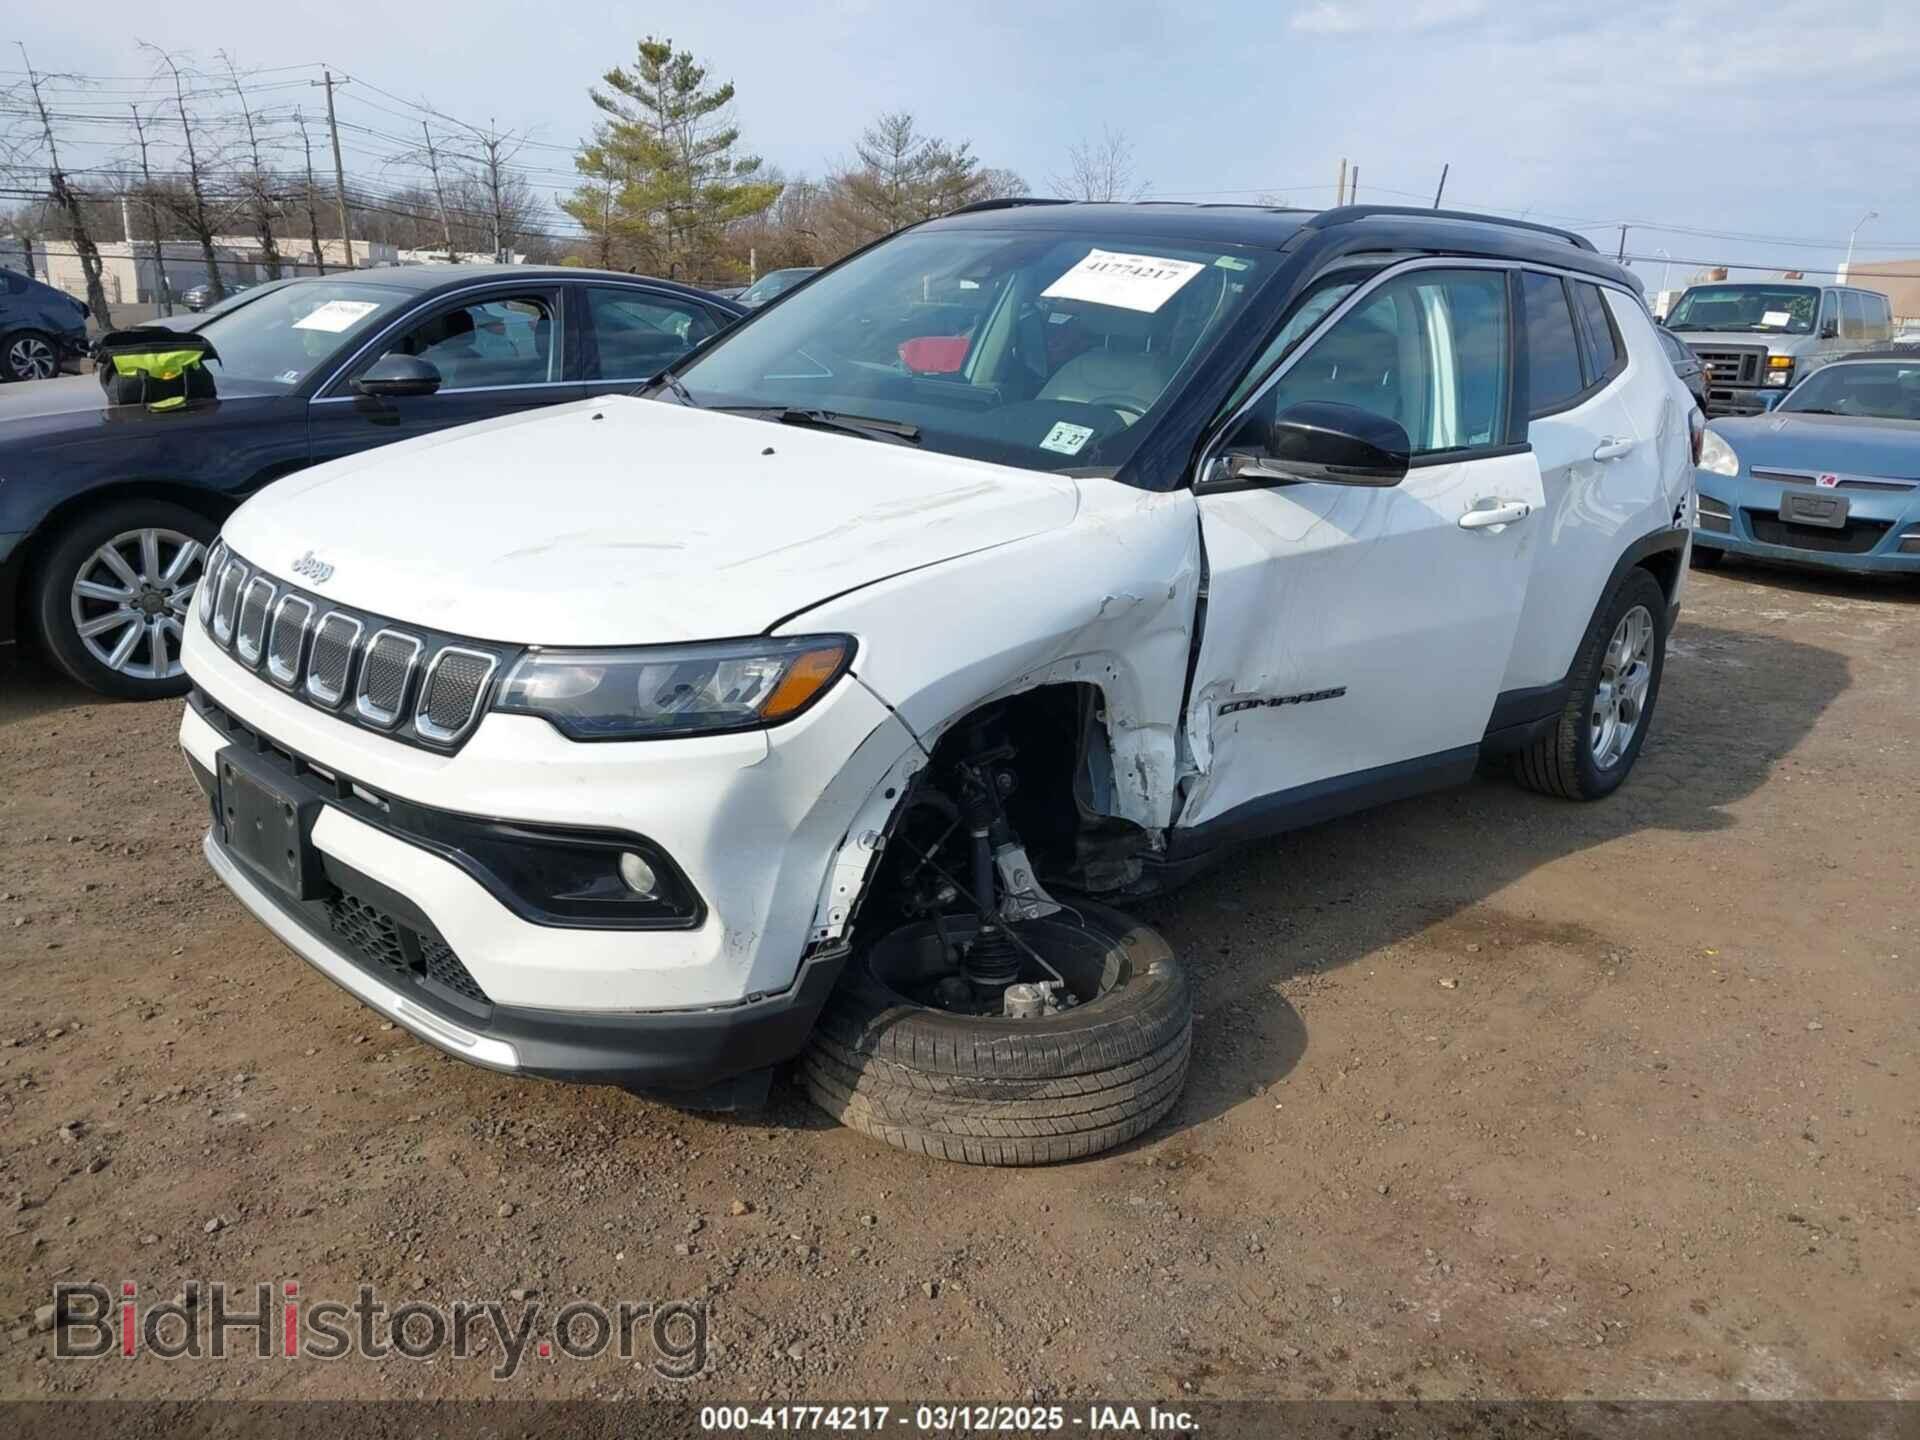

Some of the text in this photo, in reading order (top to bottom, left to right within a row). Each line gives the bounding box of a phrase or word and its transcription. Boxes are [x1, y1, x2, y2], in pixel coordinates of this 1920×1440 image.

[1087, 262, 1179, 281] 41774217
[1052, 431, 1085, 446] 3 27
[292, 550, 335, 586] Jeep
[1217, 686, 1347, 717] COMPASS
